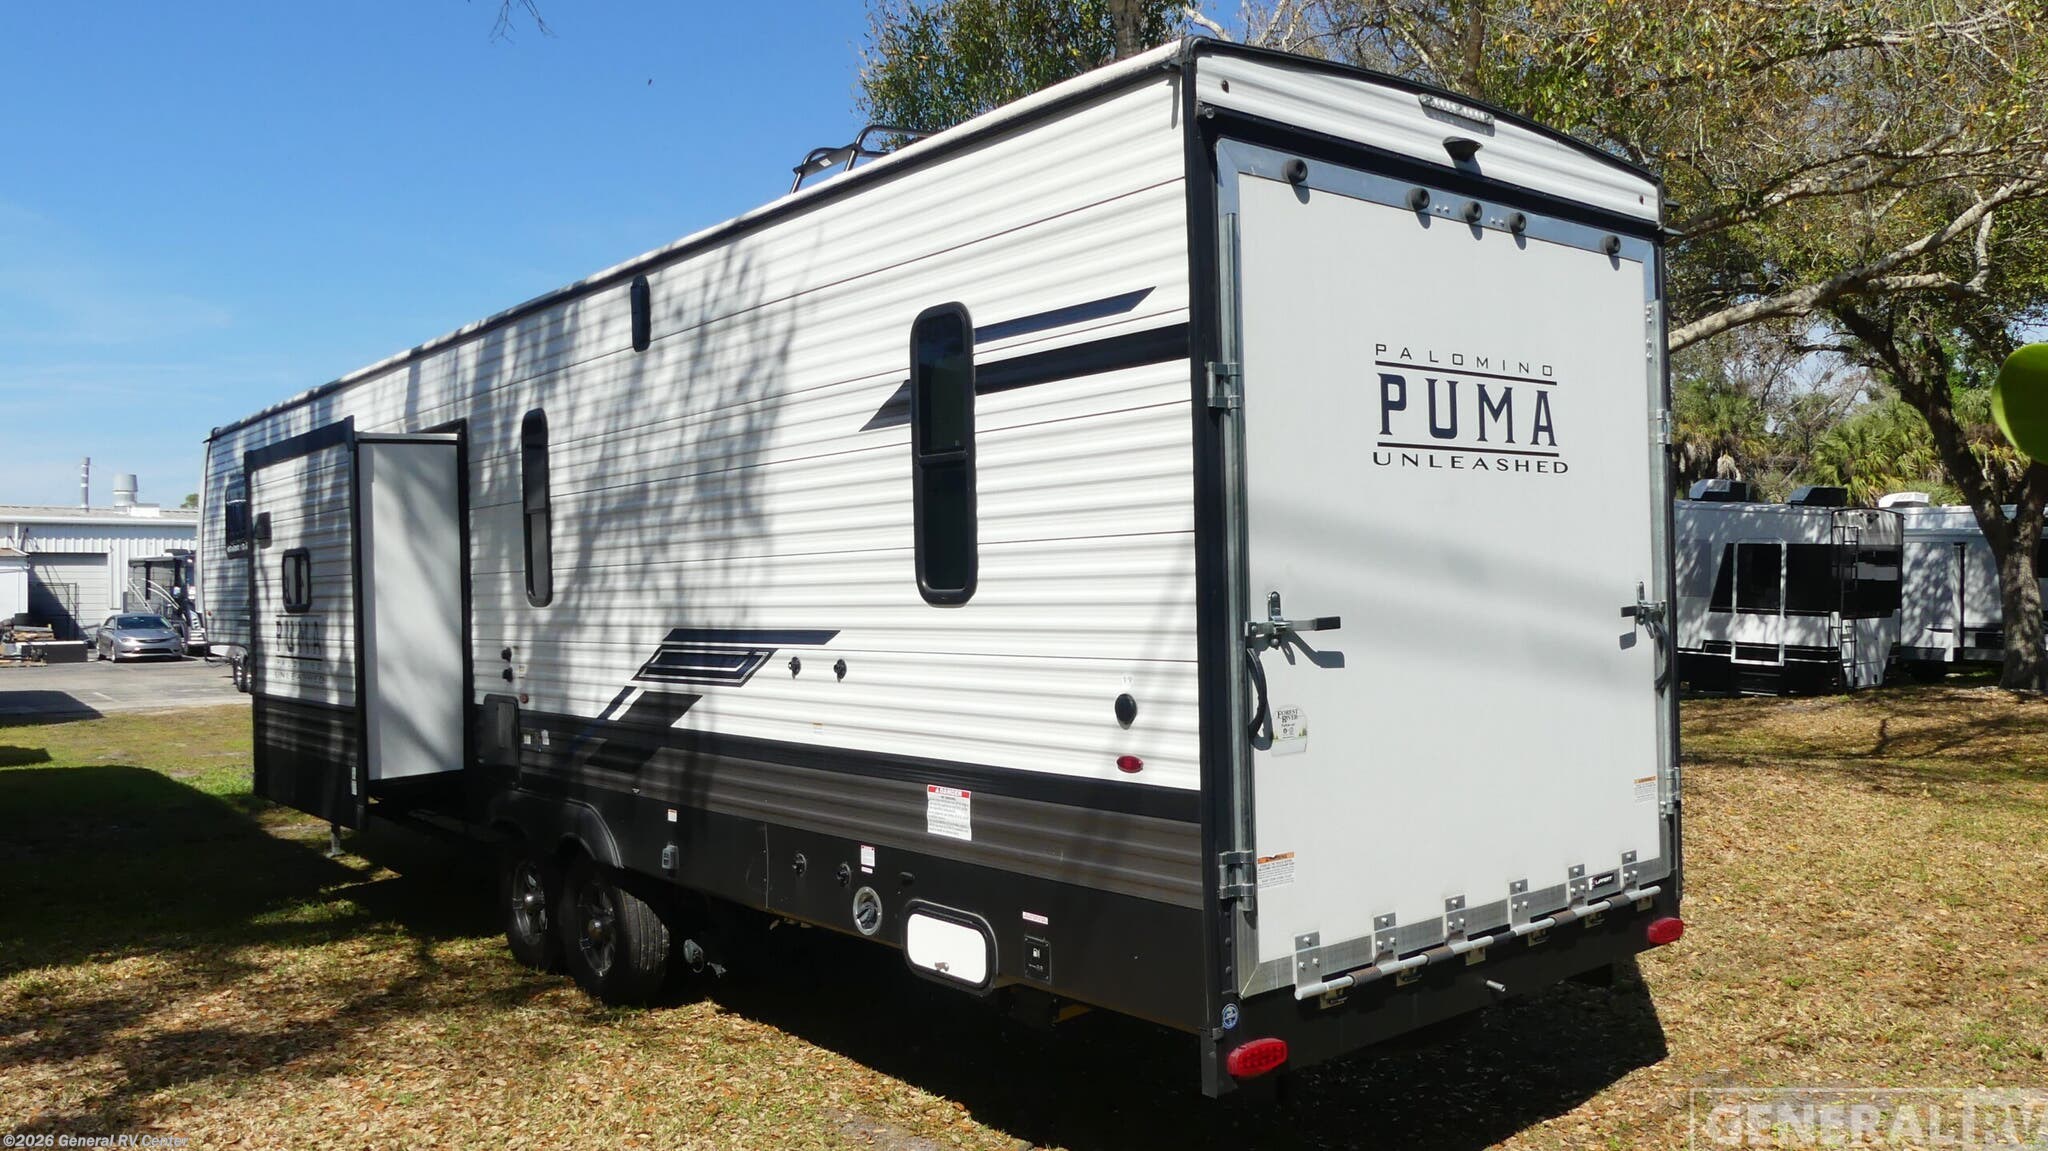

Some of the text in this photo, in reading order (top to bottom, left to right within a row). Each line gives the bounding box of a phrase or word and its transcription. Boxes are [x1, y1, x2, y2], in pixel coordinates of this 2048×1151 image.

[1375, 343, 1553, 377] PALOMINO
[1376, 372, 1558, 447] PUMA
[1372, 451, 1569, 474] UNLEASHED
[276, 620, 322, 655] PUMA
